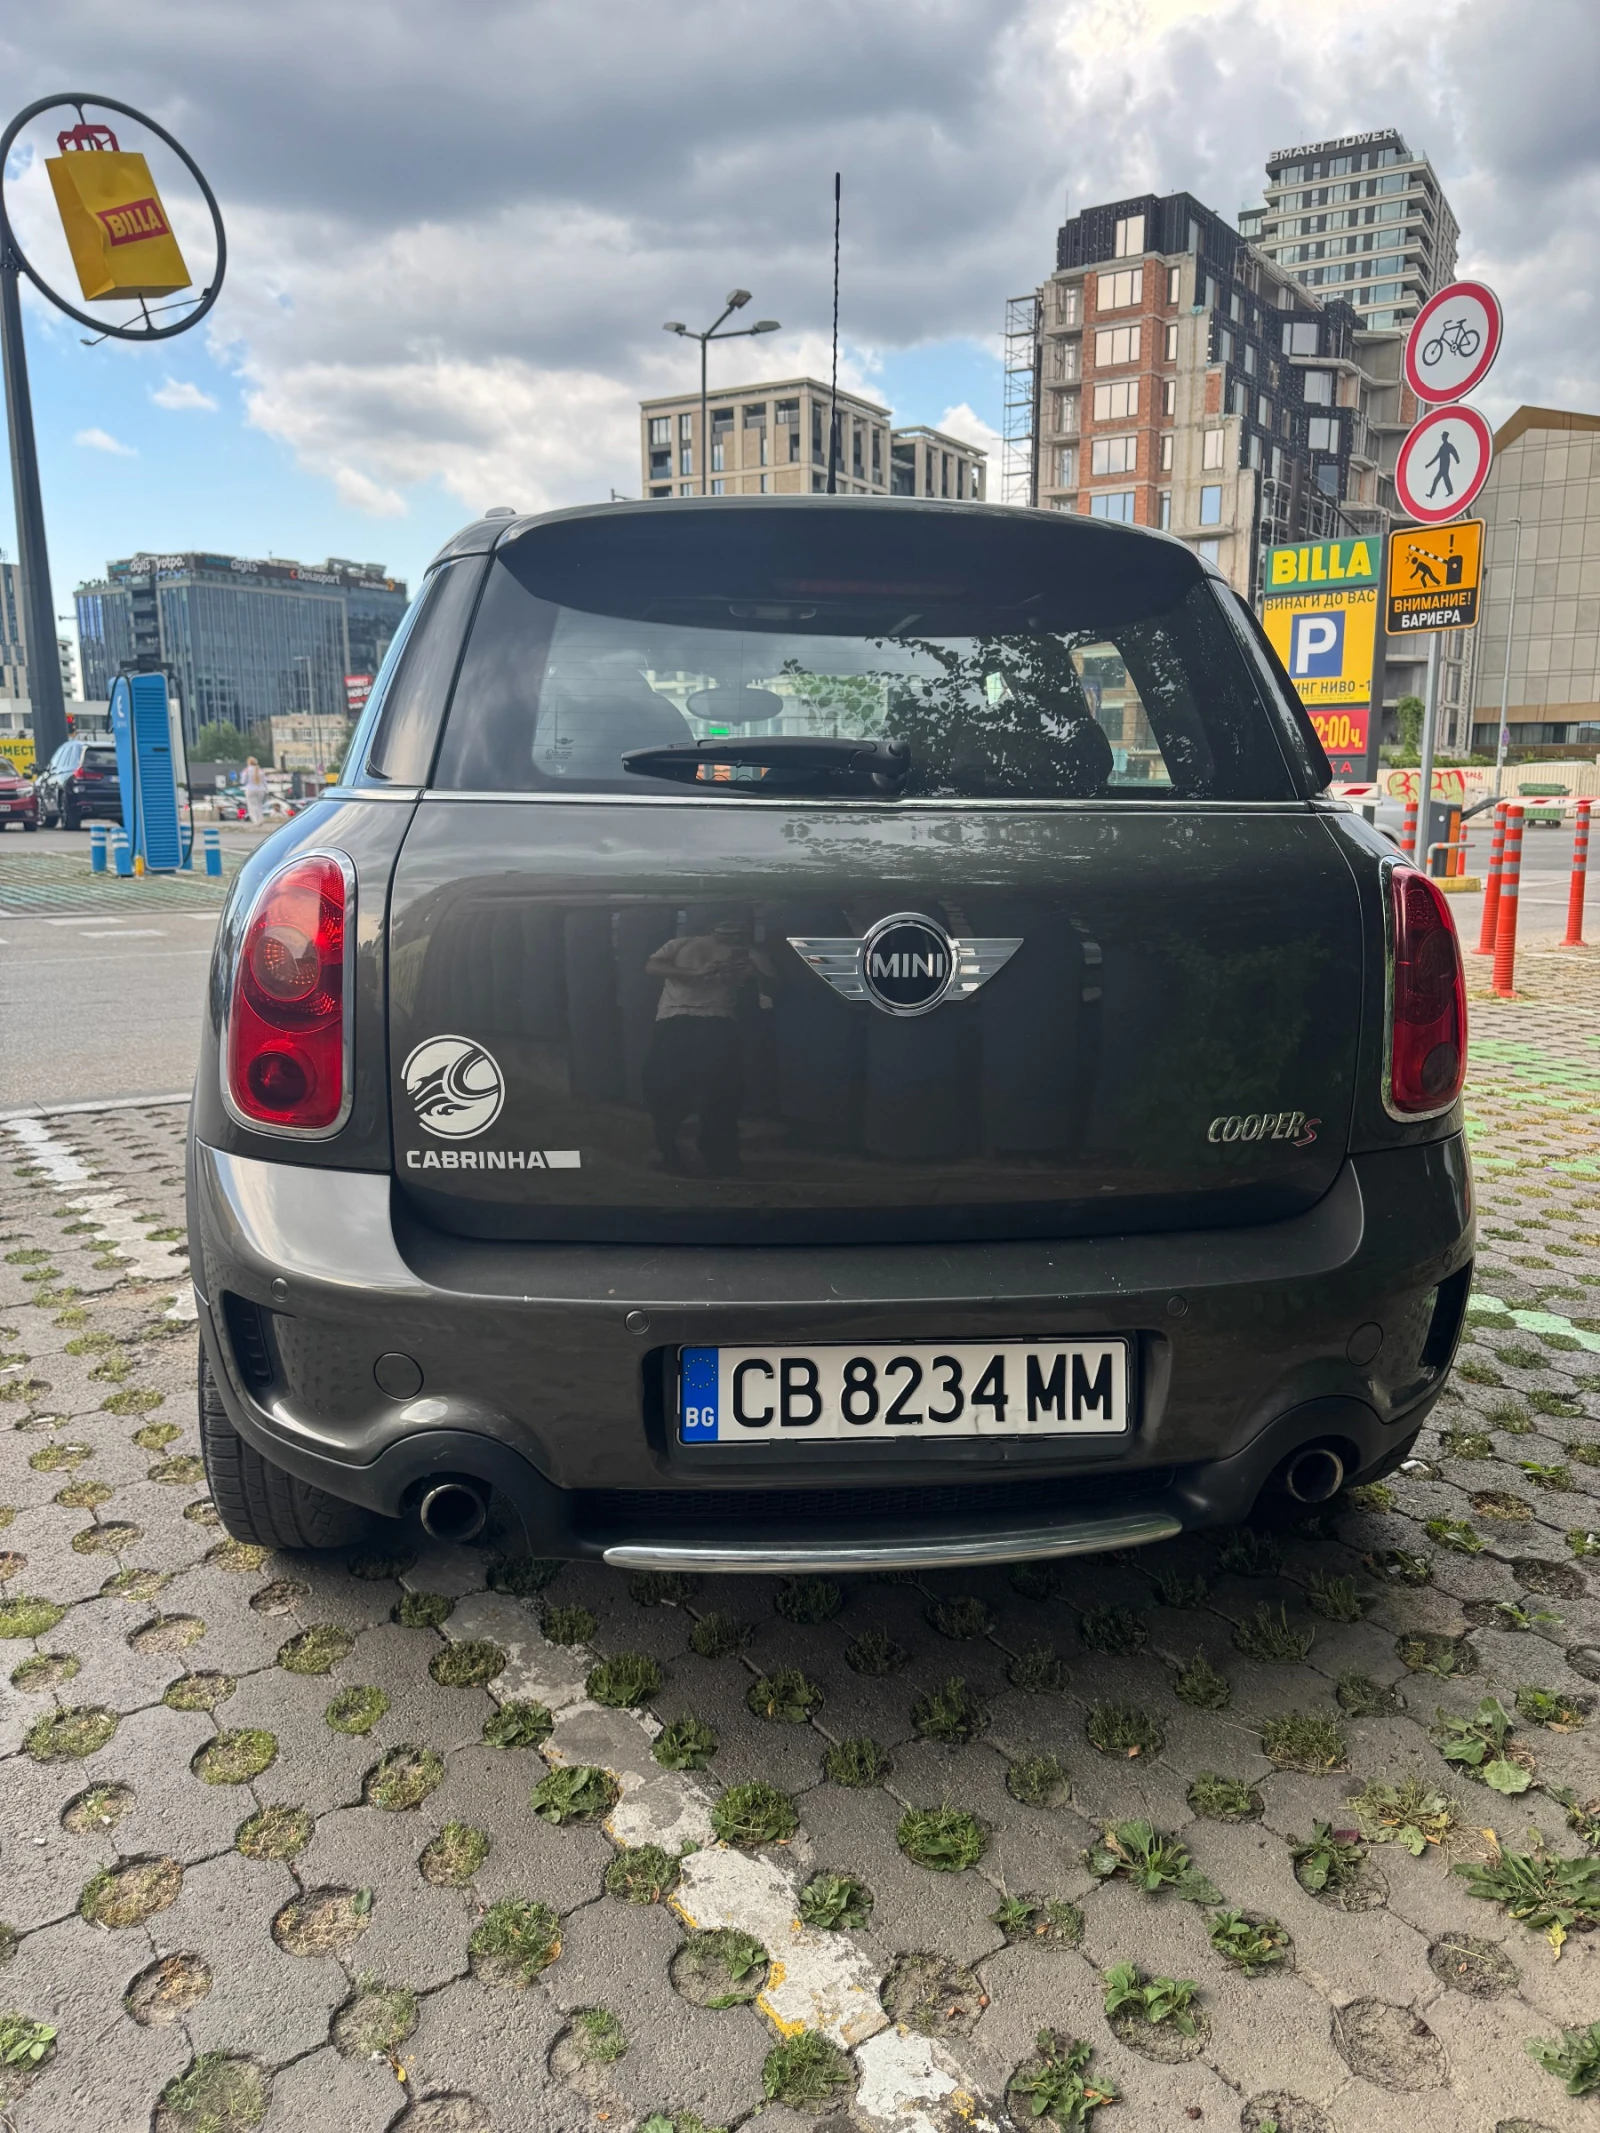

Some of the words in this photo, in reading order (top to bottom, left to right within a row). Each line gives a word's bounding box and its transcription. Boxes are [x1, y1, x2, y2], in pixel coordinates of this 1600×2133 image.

[1269, 142, 1327, 162] SMART
[1333, 128, 1396, 149] TOWER
[104, 205, 162, 239] BILLA
[1271, 541, 1372, 585] BILLA
[1266, 594, 1320, 611] ВИНАГИ
[1323, 593, 1344, 608] ДО
[1348, 590, 1376, 604] ВАС
[1394, 591, 1472, 613] ВНИМАНИЕ!
[1401, 609, 1461, 628] БАРИЕРА
[1320, 680, 1356, 694] НИВО
[872, 953, 943, 978] MINI
[1207, 1111, 1305, 1143] COOPER
[1291, 1118, 1322, 1147] S
[406, 1150, 547, 1169] CABRINHA
[731, 1356, 822, 1427] CB
[840, 1354, 1009, 1426] 8234
[1026, 1353, 1113, 1422] MM
[685, 1407, 715, 1428] BG
